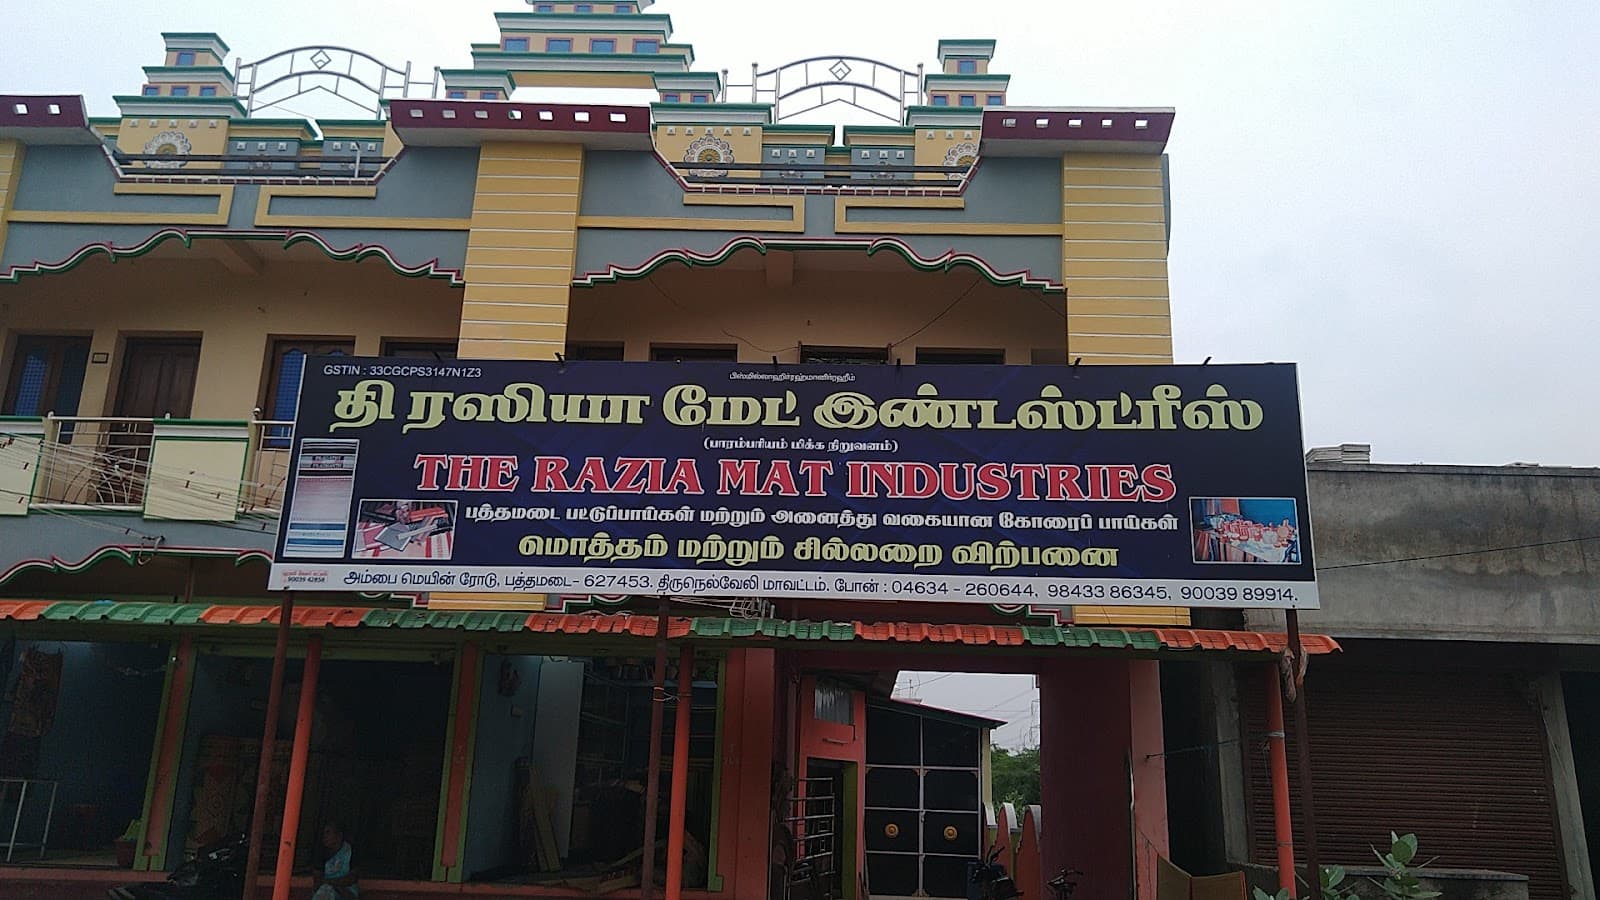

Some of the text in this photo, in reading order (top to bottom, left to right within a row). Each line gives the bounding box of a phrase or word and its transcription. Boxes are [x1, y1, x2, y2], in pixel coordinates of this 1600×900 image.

[323, 365, 361, 376] GSTIN
[369, 365, 482, 378] 33CGCPS3147N1Z3
[328, 379, 1264, 434] தி ரஸியா மேட் இண்டஸ்ட்ரீஸ்
[703, 437, 899, 453] (பாரம்பரியம் மிக்க நிறுவனம்)
[413, 453, 1177, 503] THE RAZIA MAT INDUSTRIES
[465, 503, 1179, 532] பத்தமடை பட்டுப்பாய்கள் மற்றும் அனைத்து வகையான கோரைப் பாய்கள்
[518, 531, 1120, 572] மொத்தம் மற்றும் சில்லறை விற்பனை
[343, 569, 397, 585] அம்பை
[401, 571, 456, 586] மெயின்
[656, 574, 760, 594] திருநெல்வேலி
[834, 577, 880, 594] போன்
[891, 580, 949, 595] 04634
[1047, 583, 1105, 598] 98433
[1180, 586, 1238, 601] 90039
